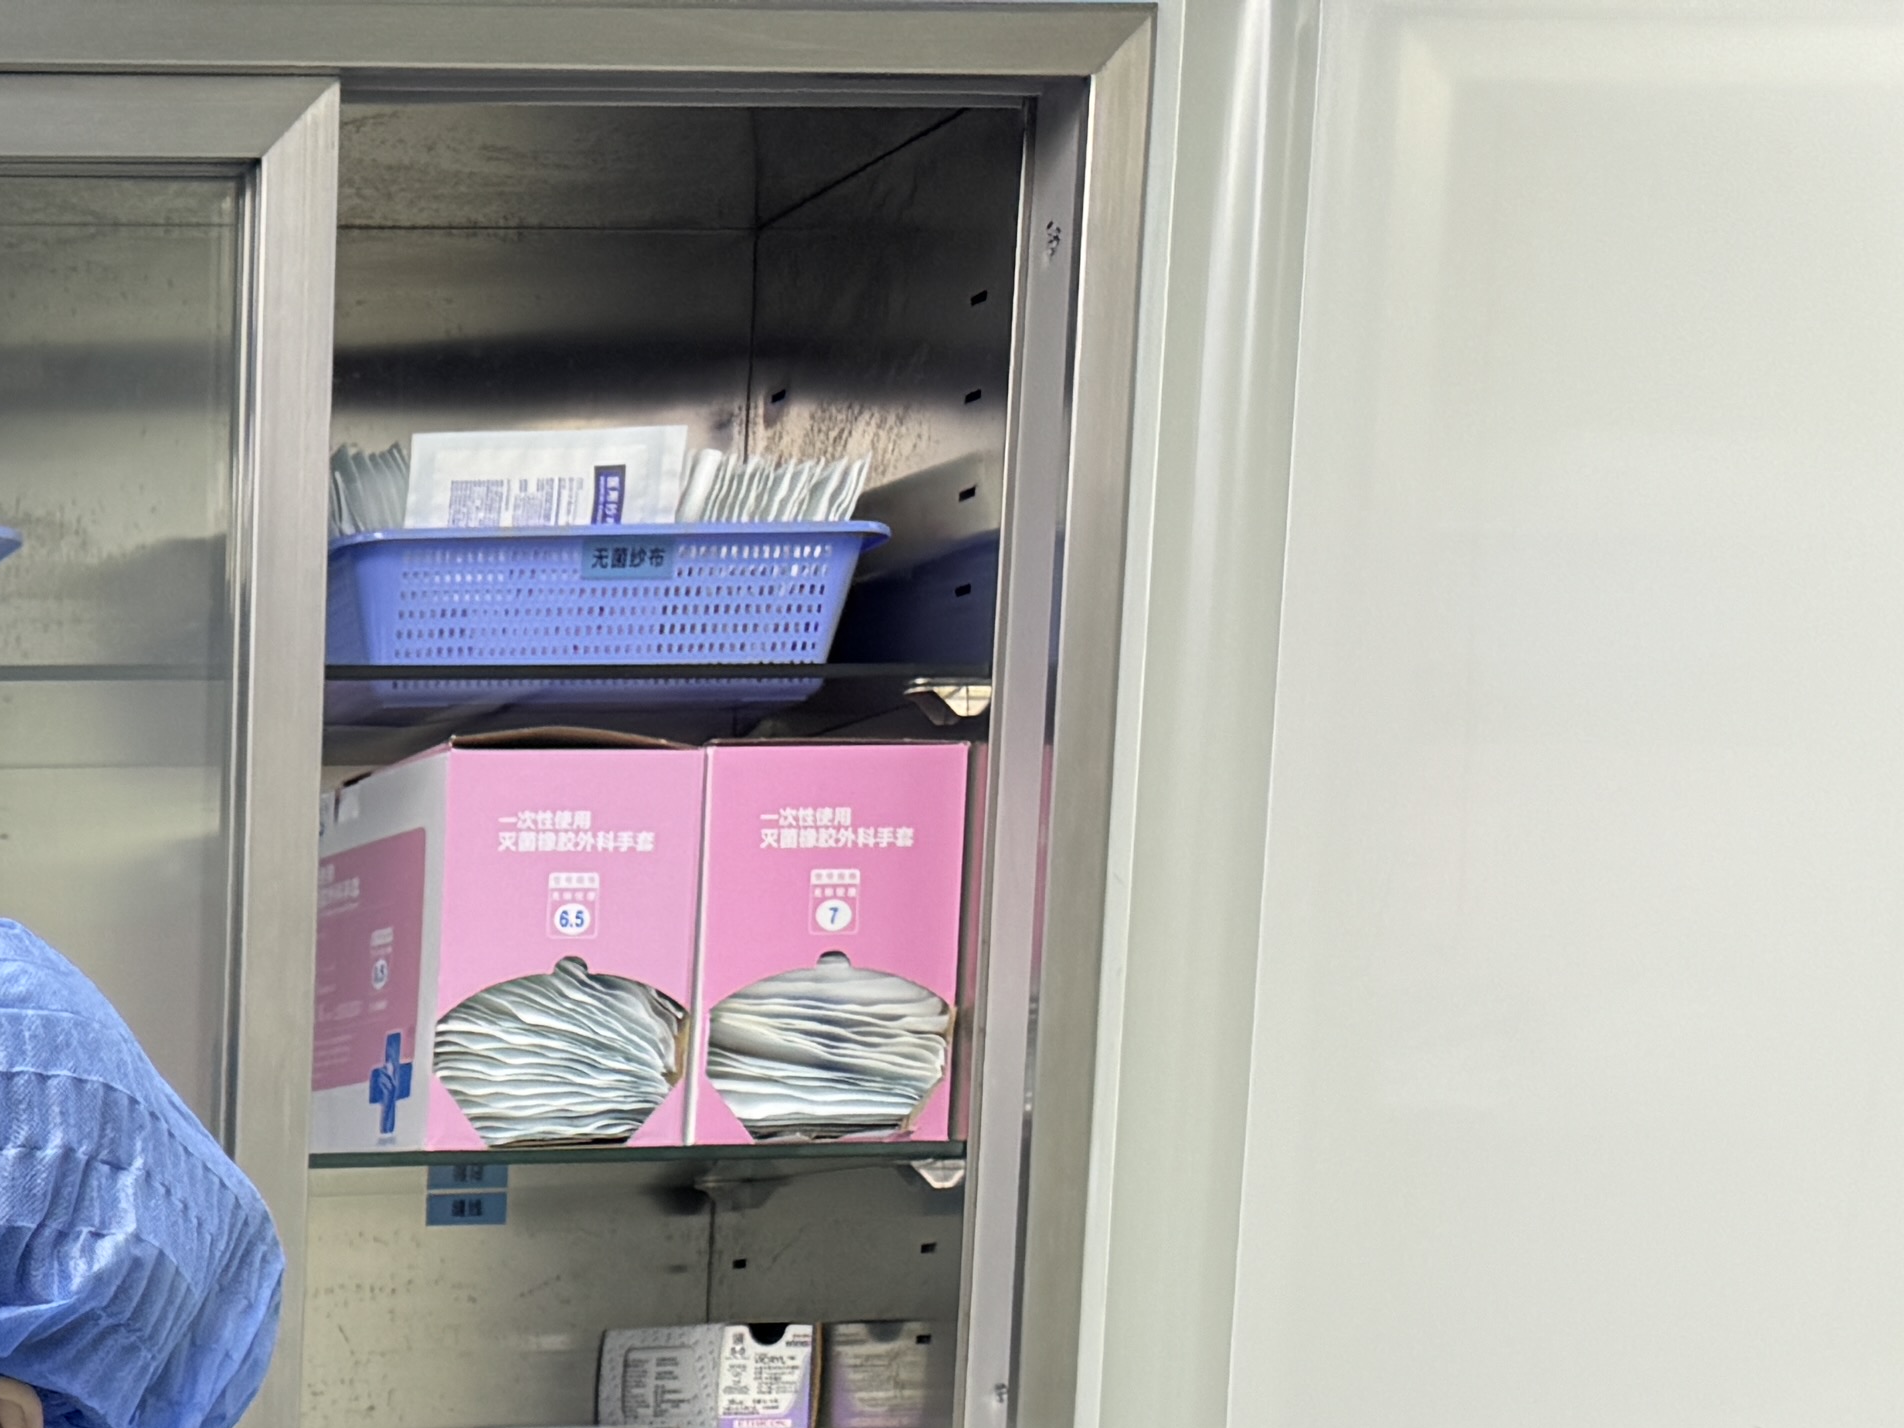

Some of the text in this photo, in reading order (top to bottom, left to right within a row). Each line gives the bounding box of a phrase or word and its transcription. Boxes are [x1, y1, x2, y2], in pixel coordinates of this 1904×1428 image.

[590, 546, 667, 569] 无菌纱布
[497, 811, 592, 831] 一次性使用
[759, 807, 852, 827] 一次性使用
[496, 831, 655, 853] 灭菌橡胶外科手套
[759, 827, 915, 849] 灭菌橡胶外科手套
[558, 909, 585, 928] 6.5
[828, 906, 840, 925] 7
